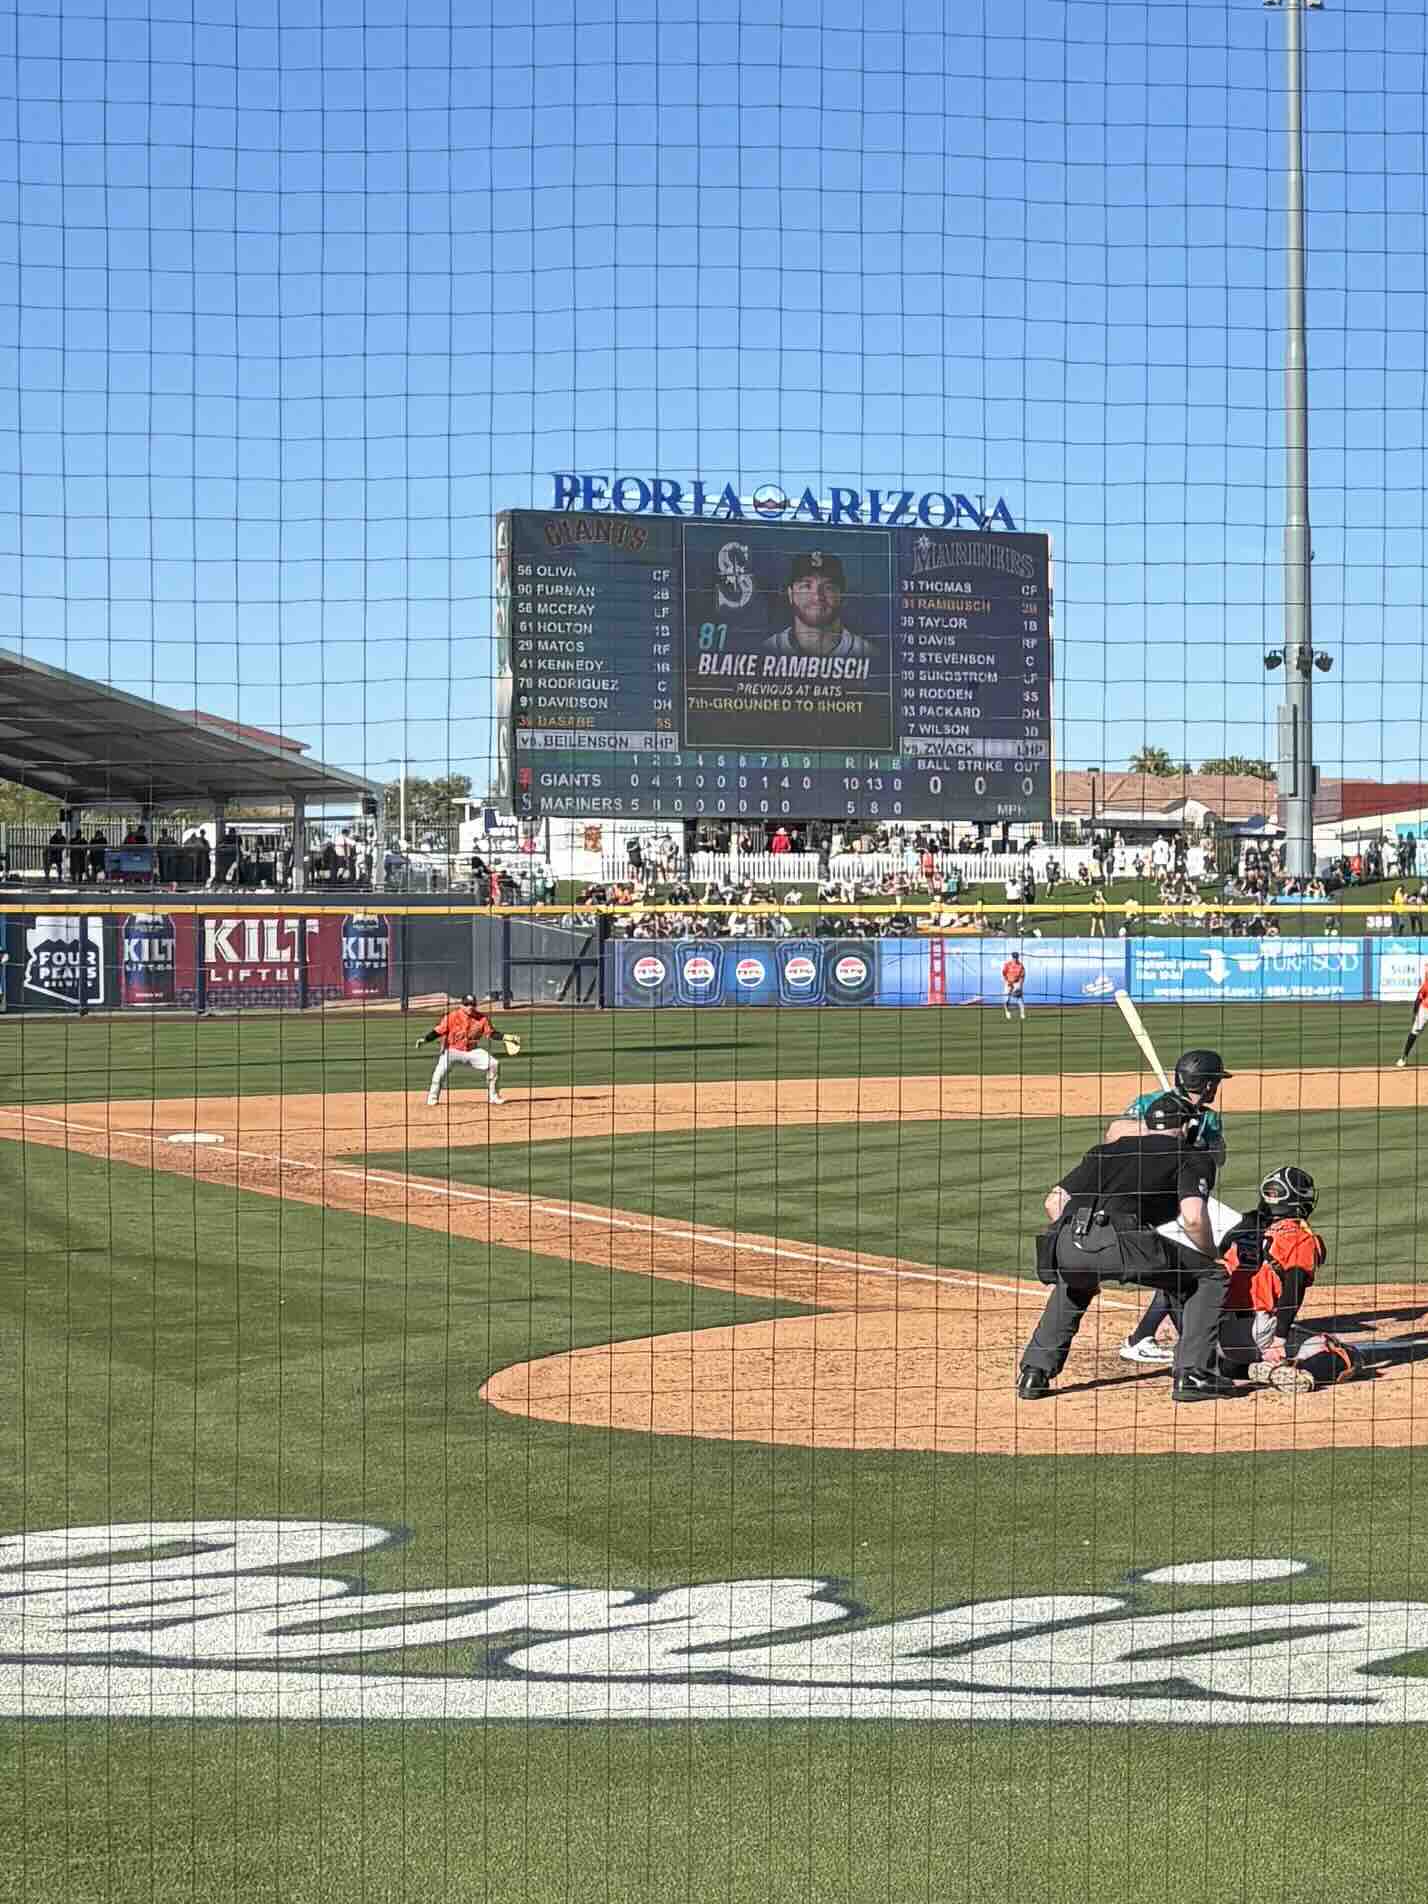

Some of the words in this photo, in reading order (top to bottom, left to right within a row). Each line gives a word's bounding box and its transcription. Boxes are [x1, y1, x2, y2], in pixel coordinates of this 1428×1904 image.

[552, 472, 744, 520] PEORIA
[790, 486, 1018, 531] ARIZONA
[652, 570, 671, 582] CF
[918, 581, 972, 593] THOMAS
[1021, 585, 1037, 596] CF
[537, 603, 595, 616] MCCRAY
[537, 622, 593, 634] HOLTON
[918, 616, 968, 629] TAYLOR
[1023, 620, 1038, 631] 1B
[699, 623, 727, 650] 81
[918, 635, 956, 646] DAVIS
[537, 640, 585, 653] MATOS
[537, 659, 604, 671] KENNEDY
[698, 653, 758, 676] BLAKE
[762, 655, 870, 680] RAMBUSCH
[919, 653, 996, 665] STEVENSON
[1025, 656, 1035, 667] C
[537, 678, 620, 691] RODRIGUEZ
[657, 681, 667, 692] C
[736, 682, 793, 696] PREVIOUS
[797, 684, 810, 696] AT
[813, 685, 843, 697] BATS
[919, 688, 973, 700] RODDEN
[537, 697, 608, 709] DAVIDSON
[653, 699, 672, 710] DH
[687, 697, 791, 712] 7th-GROUNDED
[797, 699, 814, 712] TO
[818, 700, 864, 713] SHORT
[919, 707, 981, 719] PACKARD
[908, 724, 915, 734] 7
[919, 724, 969, 735] WILSON
[544, 736, 629, 748] BEILENSON
[643, 736, 673, 748] RHP
[927, 743, 975, 756] ZWACK
[632, 754, 638, 765] 1
[673, 754, 682, 766] 3
[760, 756, 768, 767] 7
[846, 757, 856, 769] R
[869, 758, 879, 770] H
[918, 759, 950, 770] BALL
[958, 760, 1004, 772] STRIKE
[1015, 761, 1040, 773] OUT
[540, 774, 601, 787] GIANTS
[630, 774, 639, 786] 0
[651, 775, 660, 787] 4
[675, 776, 682, 787] 1
[696, 776, 704, 788] 0
[717, 776, 726, 788] 0
[739, 776, 747, 788] 0
[761, 777, 768, 788] 1
[780, 776, 790, 788] 4
[802, 777, 811, 789] 0
[843, 777, 858, 790] 10
[867, 777, 882, 790] 13
[893, 778, 902, 791] 0
[929, 776, 942, 794] 0
[974, 776, 987, 794] 0
[1022, 777, 1033, 795] 0
[540, 798, 622, 811] MARINERS
[631, 799, 639, 810] 5
[674, 799, 682, 811] 0
[696, 799, 704, 811] 0
[717, 800, 726, 812] 0
[739, 800, 747, 812] 0
[760, 800, 768, 812] 0
[781, 800, 790, 812] 0
[847, 801, 855, 814] 5
[871, 801, 879, 814] 8
[893, 801, 902, 814] 0
[204, 919, 319, 962] KILT
[124, 938, 175, 962] KILT
[341, 936, 389, 960] KILT
[39, 951, 96, 965] FOUR
[39, 967, 96, 980] PEAS
[210, 969, 300, 982] LIFTE
